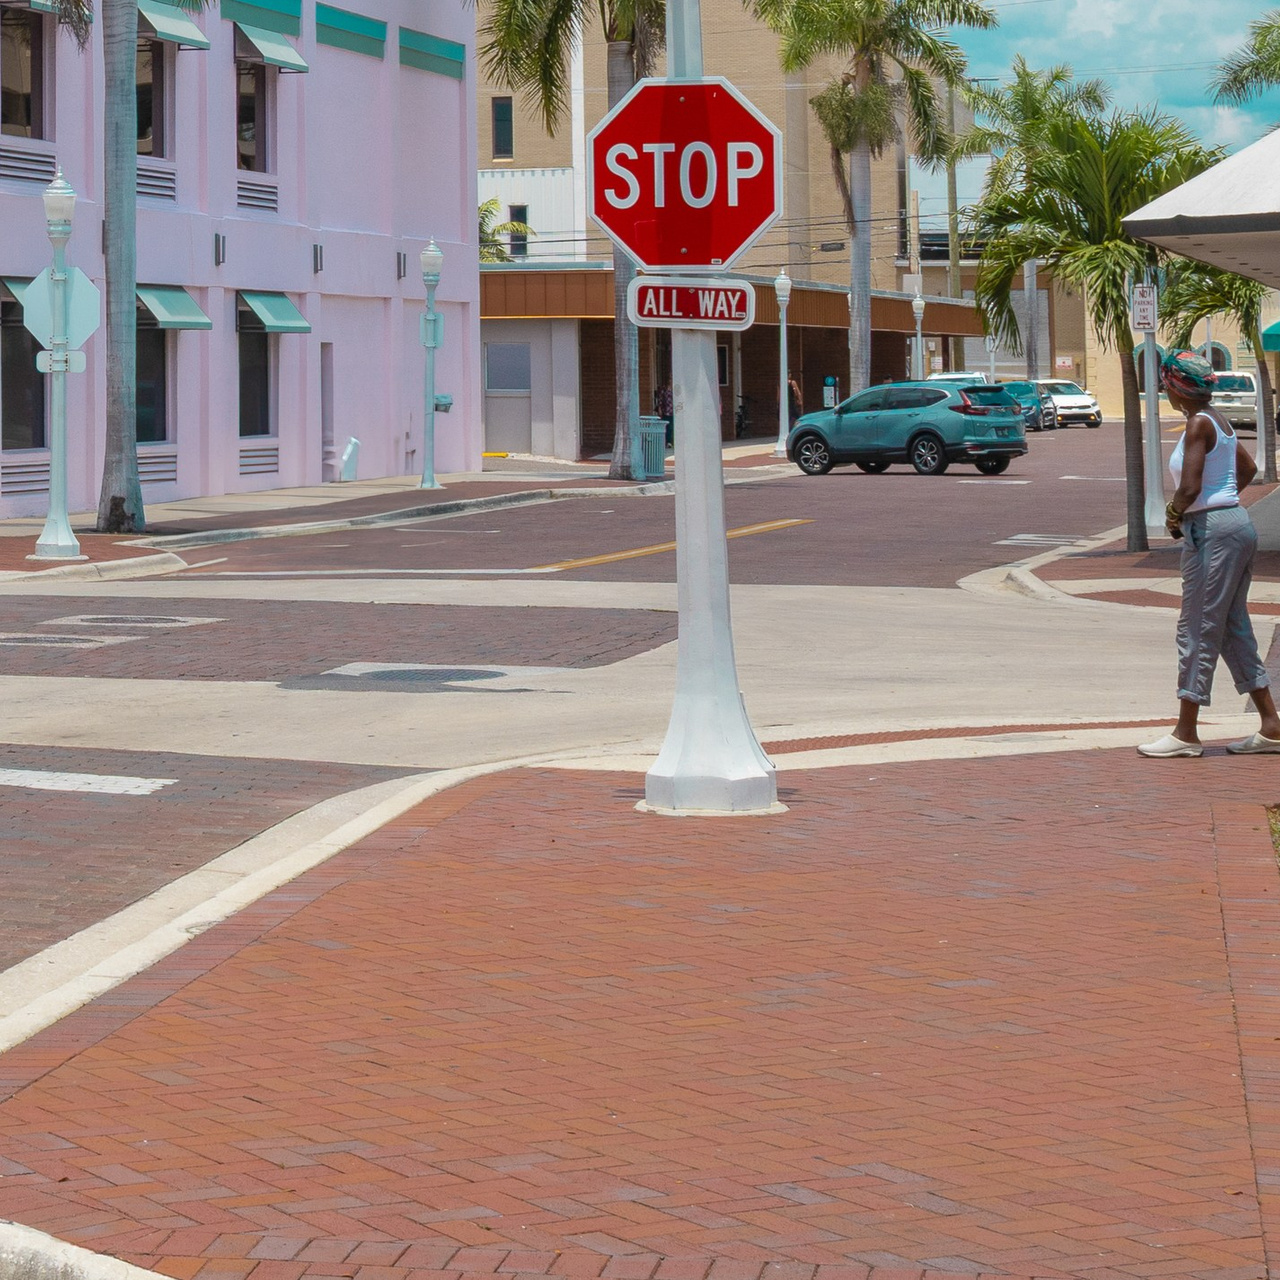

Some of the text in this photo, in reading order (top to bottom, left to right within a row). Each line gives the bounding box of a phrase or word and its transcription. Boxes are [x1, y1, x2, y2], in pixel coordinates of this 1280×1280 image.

[604, 141, 764, 210] STOP
[643, 289, 741, 318] ALL WAY
[1138, 290, 1147, 298] NO
